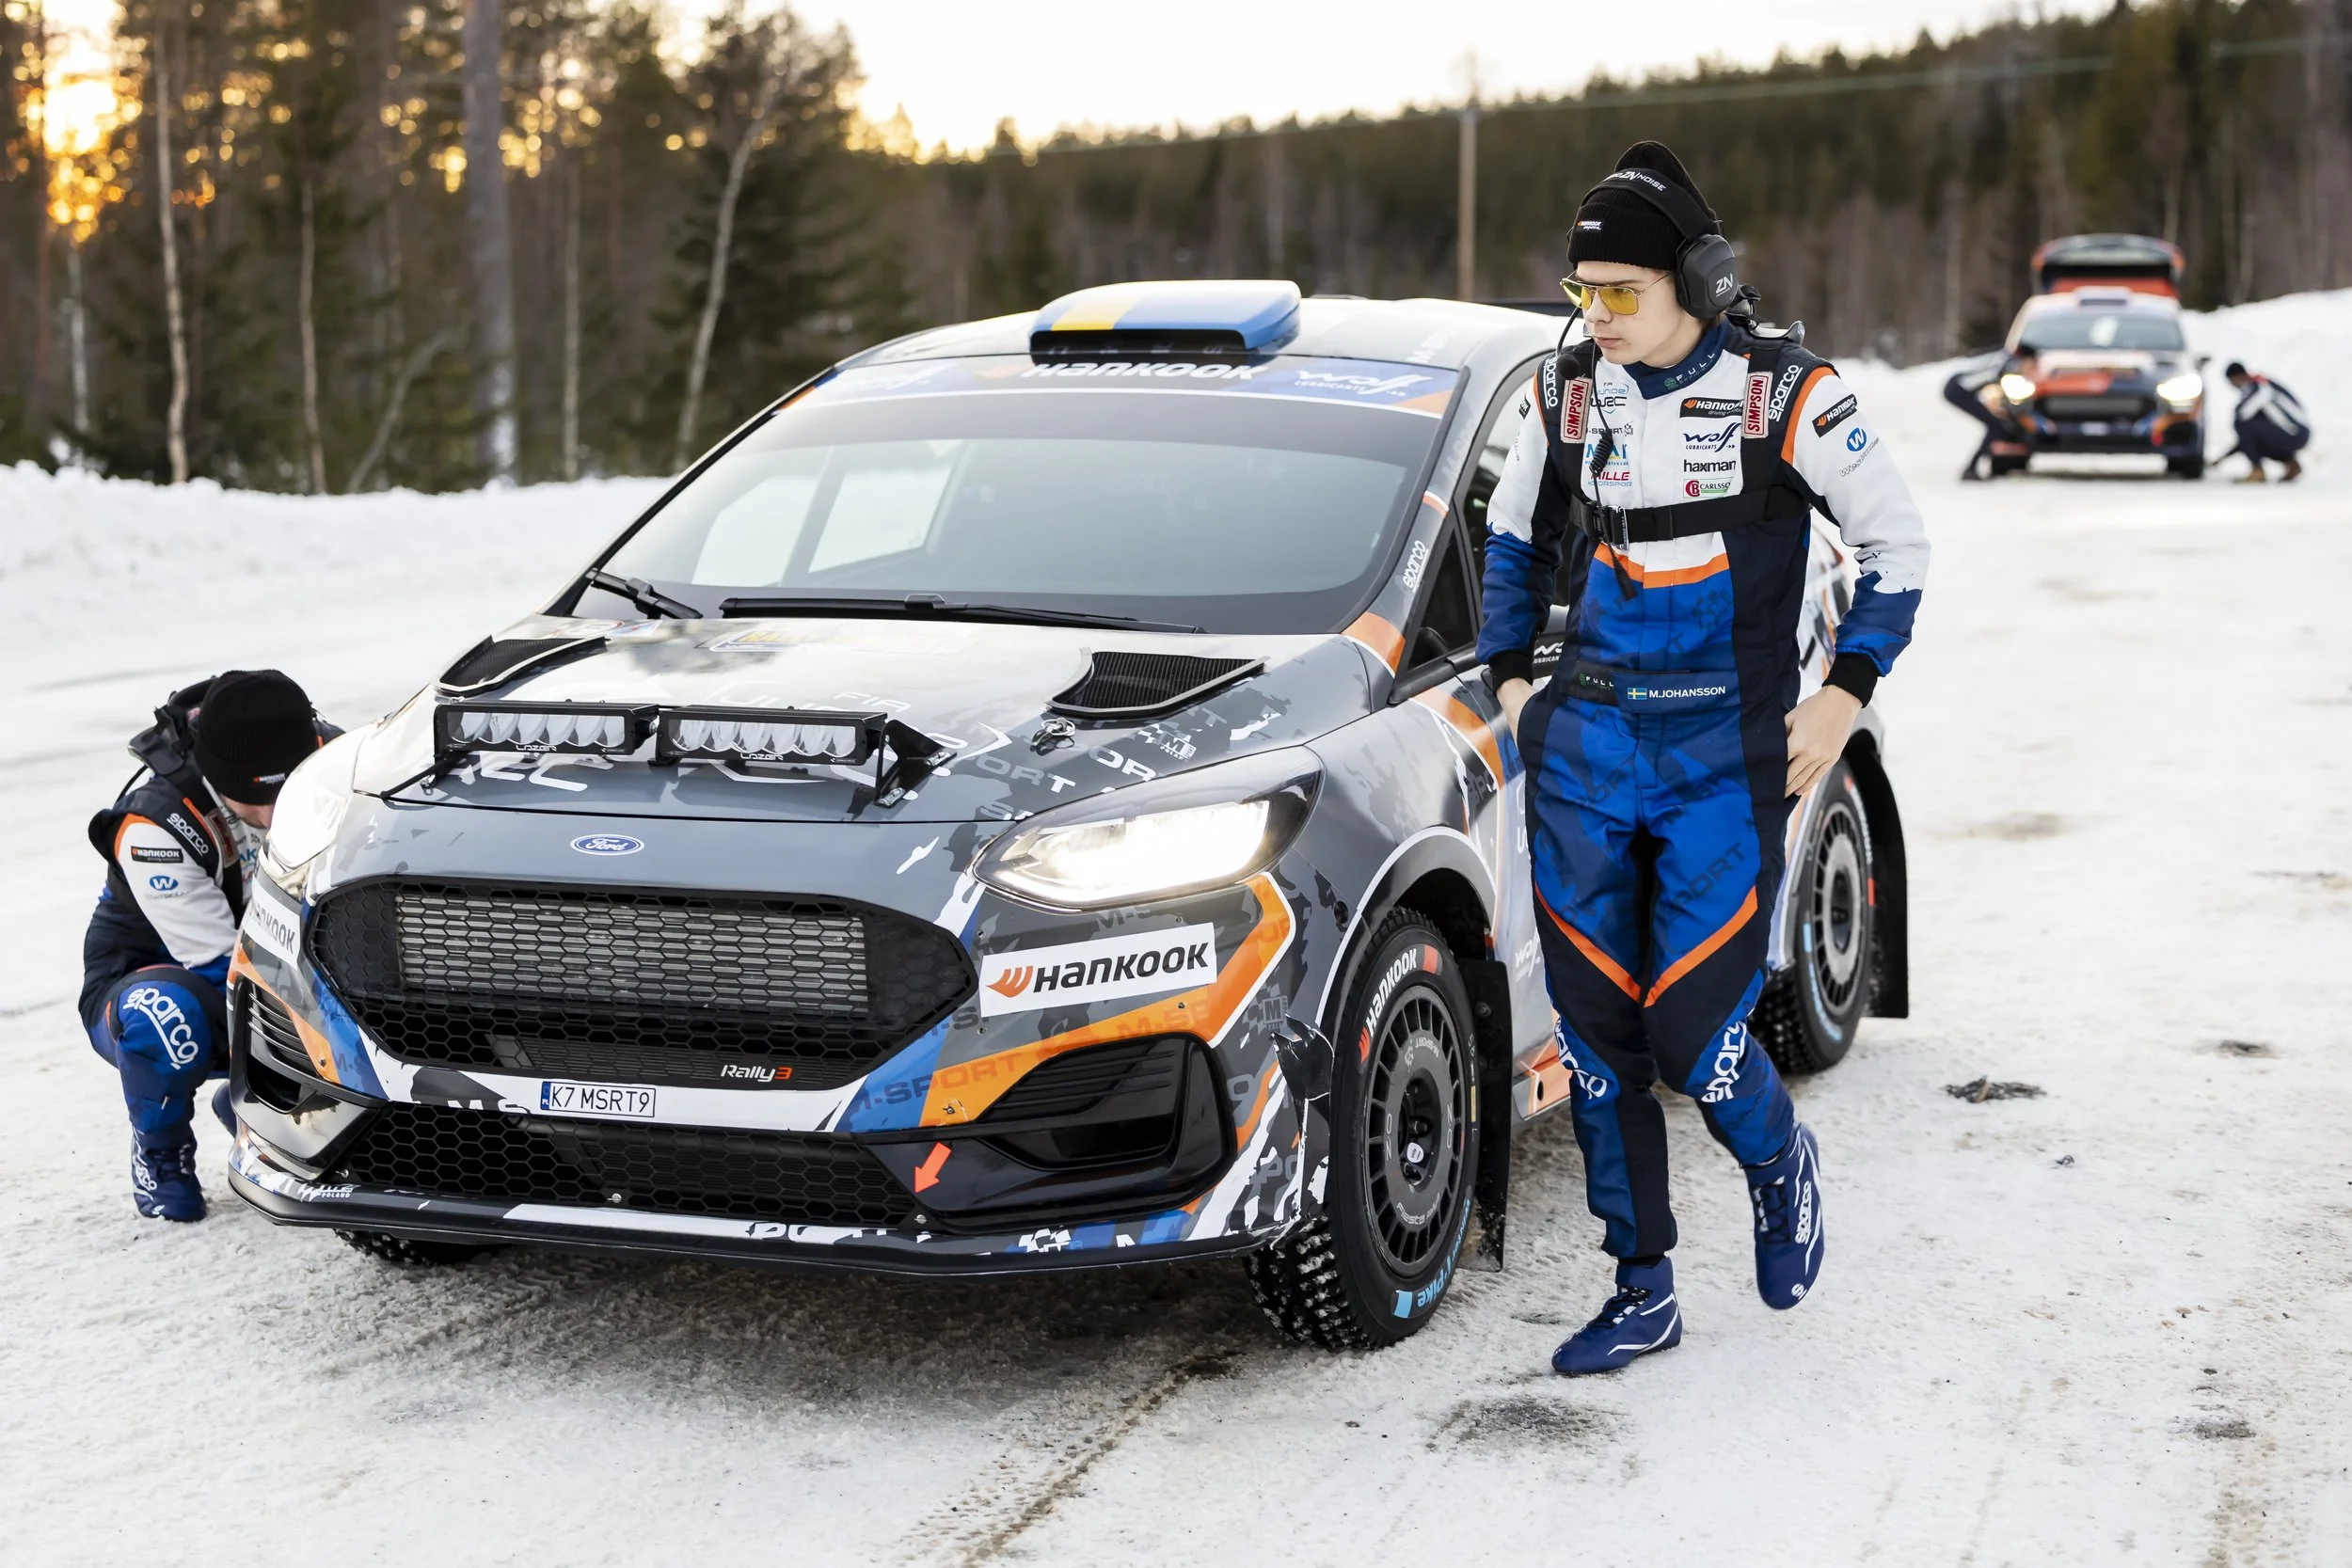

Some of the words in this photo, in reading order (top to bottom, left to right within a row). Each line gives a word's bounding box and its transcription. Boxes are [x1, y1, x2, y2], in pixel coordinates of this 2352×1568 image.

[1638, 174, 1666, 192] NOISE
[1716, 274, 1734, 294] ZN
[1021, 362, 1268, 380] HANKOOK
[1677, 354, 1715, 381] FULL
[1747, 378, 1764, 433] SIMPSON
[1768, 365, 1803, 421] sparco
[1566, 384, 1585, 436] SIMPSON
[1683, 422, 1740, 452] wolf
[1683, 459, 1737, 472] haxman
[1403, 540, 1430, 594] sparco
[1586, 675, 1614, 687] FULL
[1648, 686, 1726, 698] M.JOHANSSON
[833, 691, 912, 713] FIA
[167, 812, 209, 857] sparco
[585, 838, 629, 851] Ford
[1033, 942, 1209, 994] HANKOOK
[1365, 947, 1417, 1038] HANKOOK
[123, 987, 199, 1069] sparco
[721, 1064, 793, 1083] Rally3
[551, 1085, 575, 1108] K7
[580, 1087, 650, 1113] MSRT9
